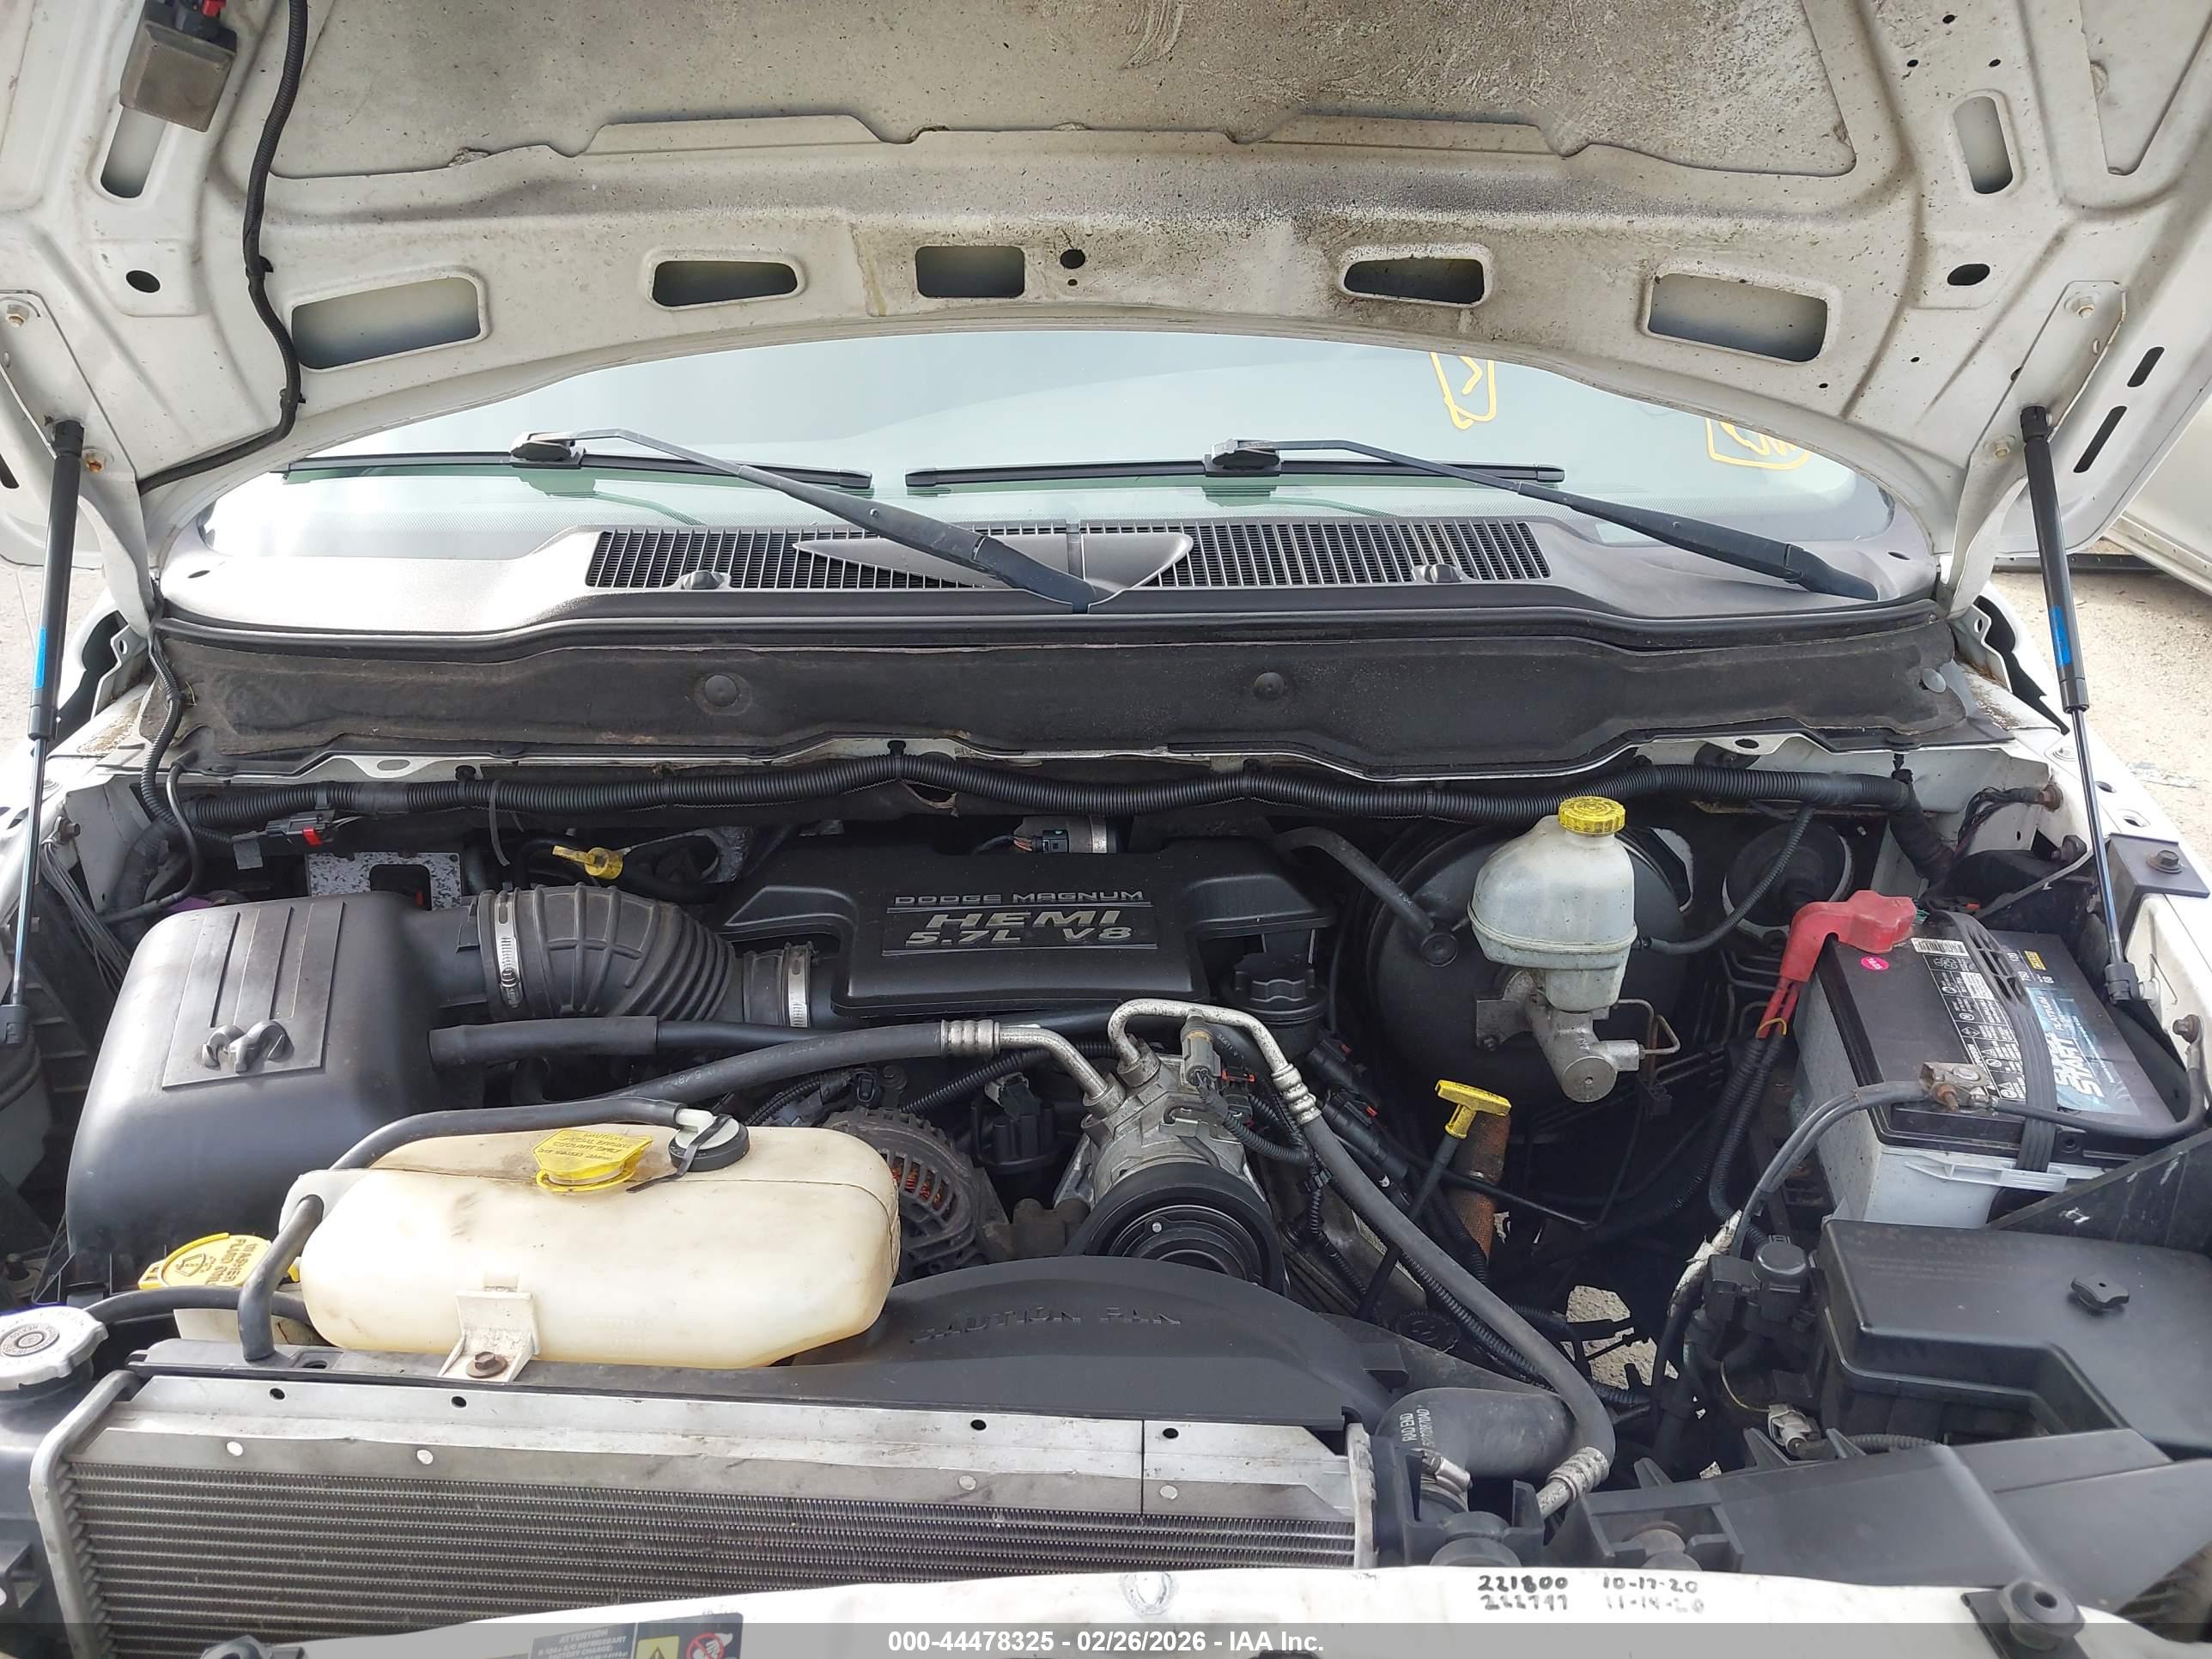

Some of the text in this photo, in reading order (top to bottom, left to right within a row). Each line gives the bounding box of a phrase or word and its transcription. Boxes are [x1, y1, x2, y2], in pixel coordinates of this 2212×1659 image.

[894, 890, 1144, 906] DODGE MAGNUM
[926, 910, 1121, 928] HEMI
[905, 927, 1133, 945] 5.7L V8
[2060, 1037, 2106, 1098] START
[909, 1306, 1182, 1344] CAUTION FAN
[1400, 1413, 1418, 1442] RAD END
[1477, 1575, 1699, 1594] 221800 10-17-20
[559, 1628, 609, 1644] ATTENTION
